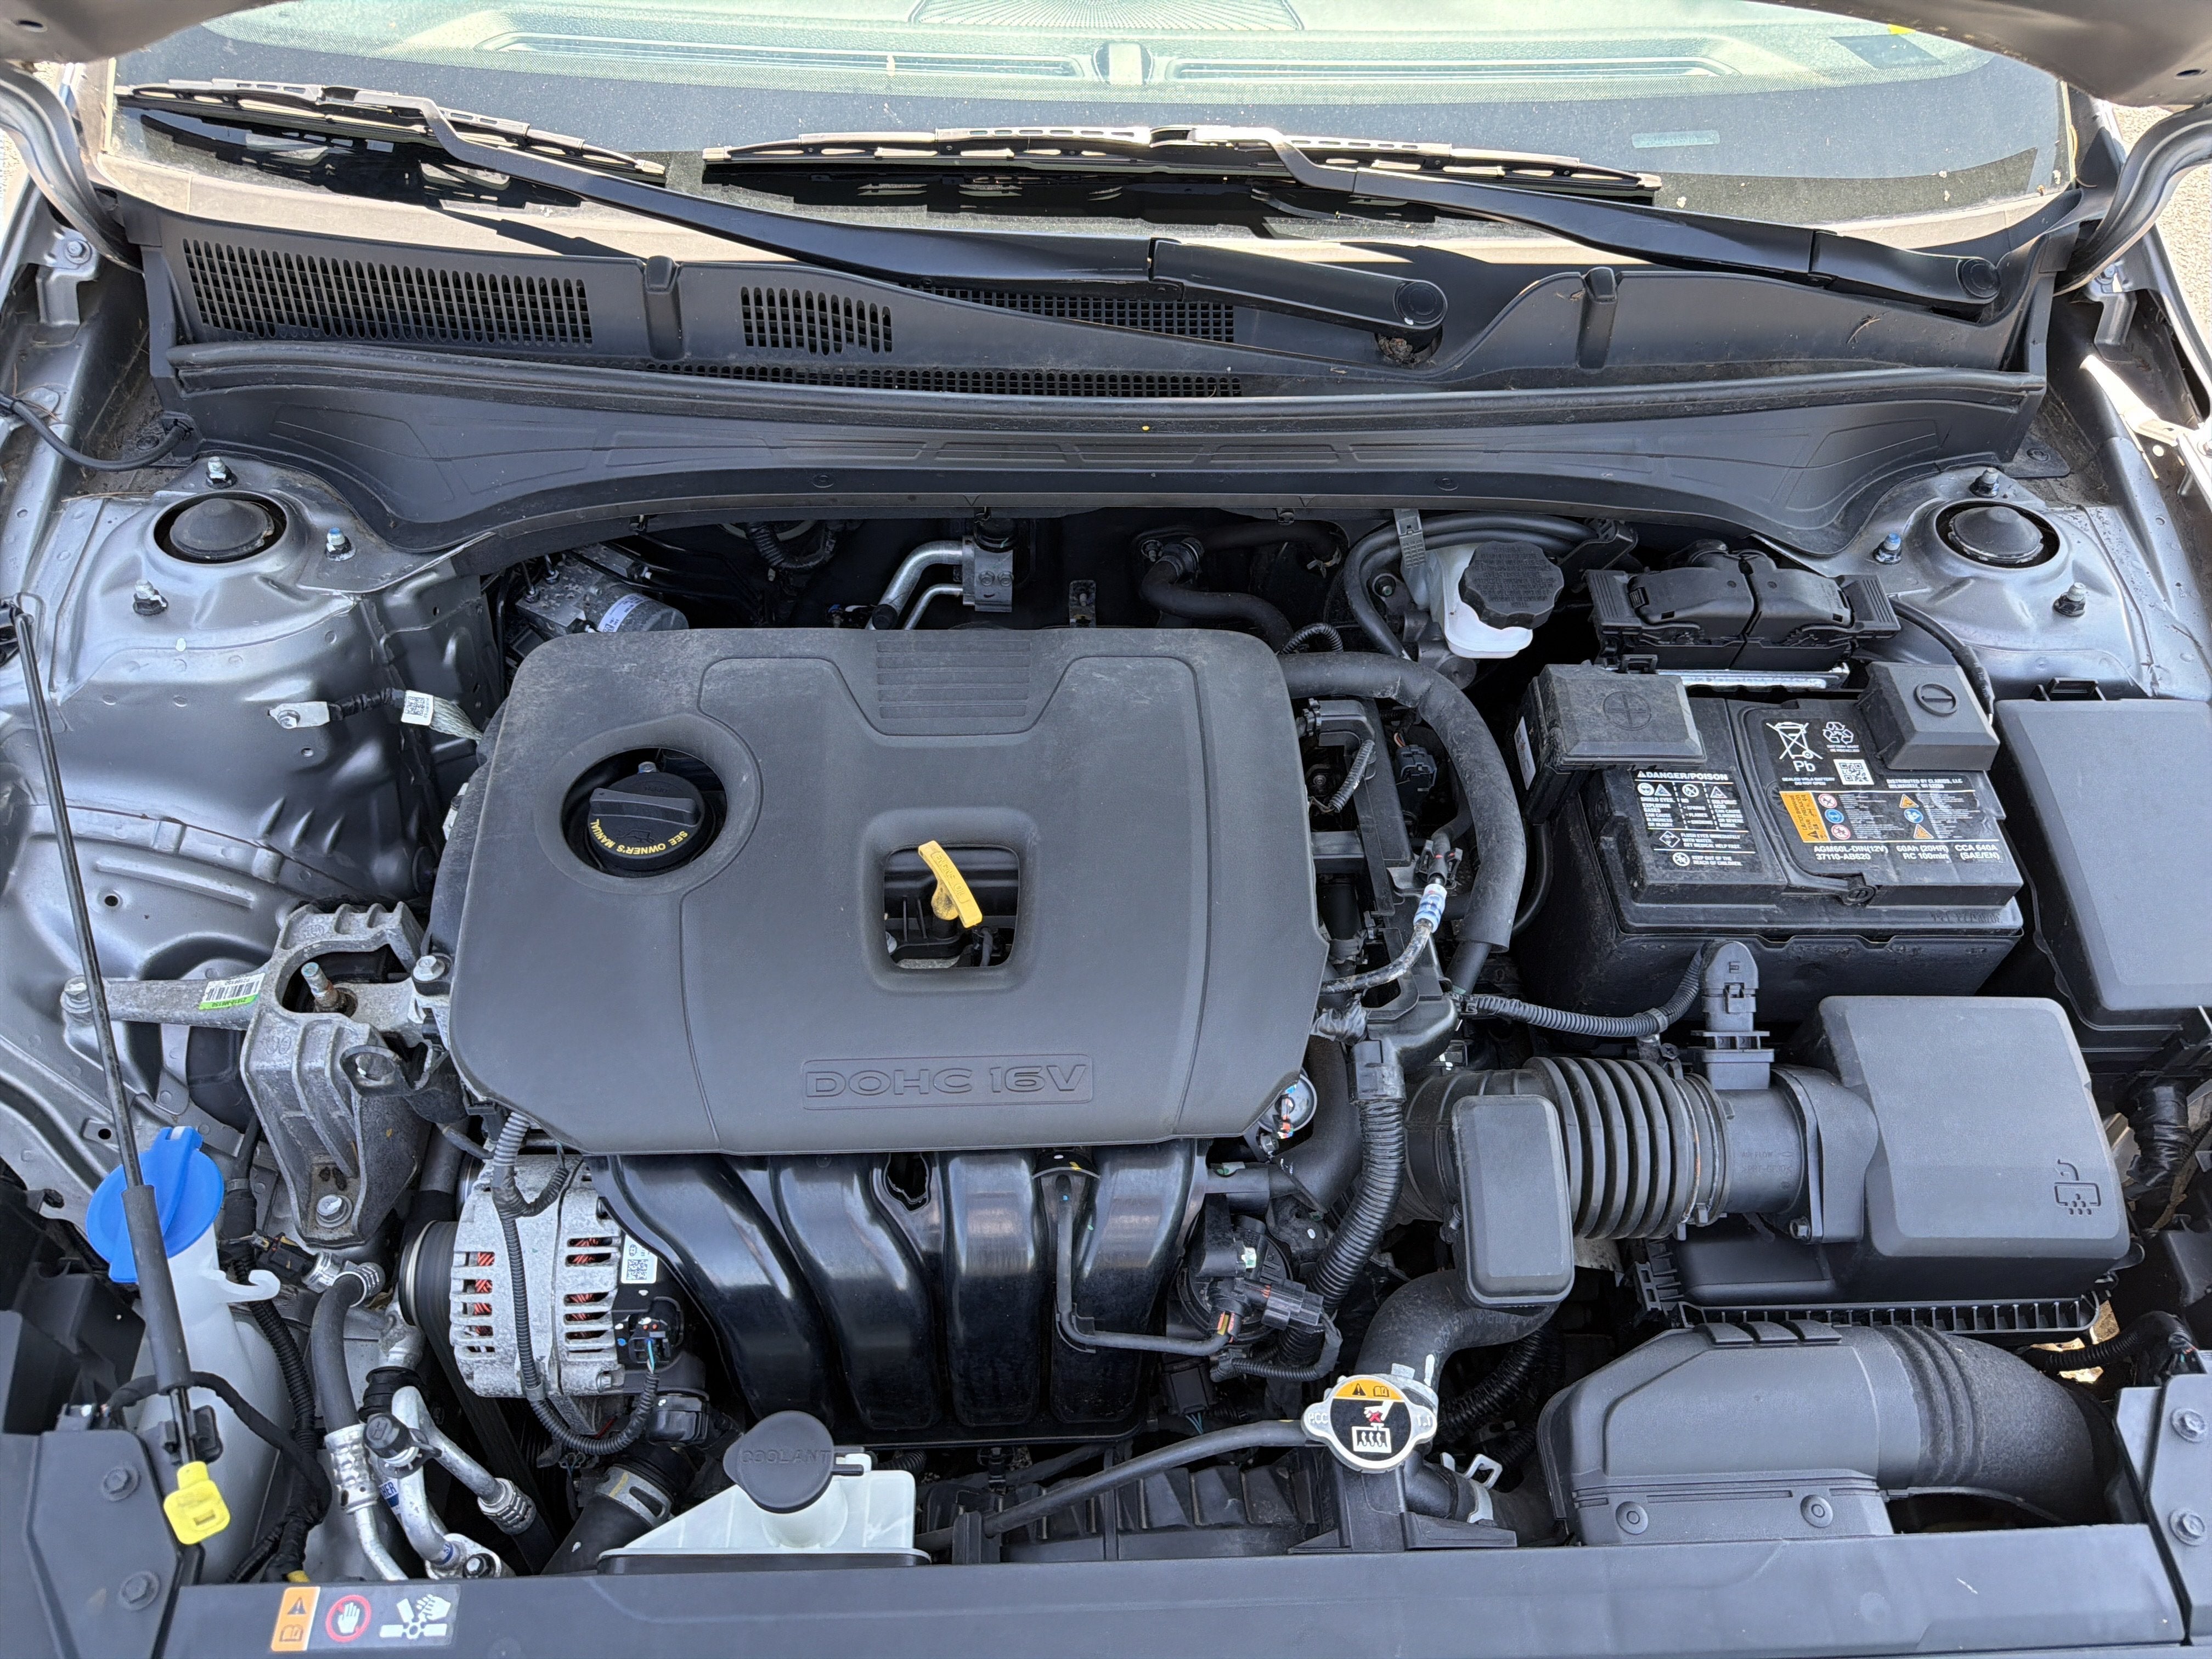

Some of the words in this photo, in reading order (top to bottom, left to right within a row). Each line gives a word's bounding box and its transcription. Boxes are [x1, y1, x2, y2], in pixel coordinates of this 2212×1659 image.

[1792, 760, 1816, 772] Pb
[1645, 771, 1729, 780] DANGER/POISON
[590, 818, 616, 849] MANUAL
[668, 830, 689, 846] SEE
[616, 843, 667, 855] OWNER'S
[1920, 845, 1949, 853] (20HR)
[1960, 852, 2000, 860] (SAE/EN)
[935, 853, 956, 880] ENGINE
[953, 883, 966, 899] OIL
[806, 1068, 973, 1097] DOHC
[989, 1064, 1087, 1093] 16V
[741, 1449, 832, 1464] COOLANT
